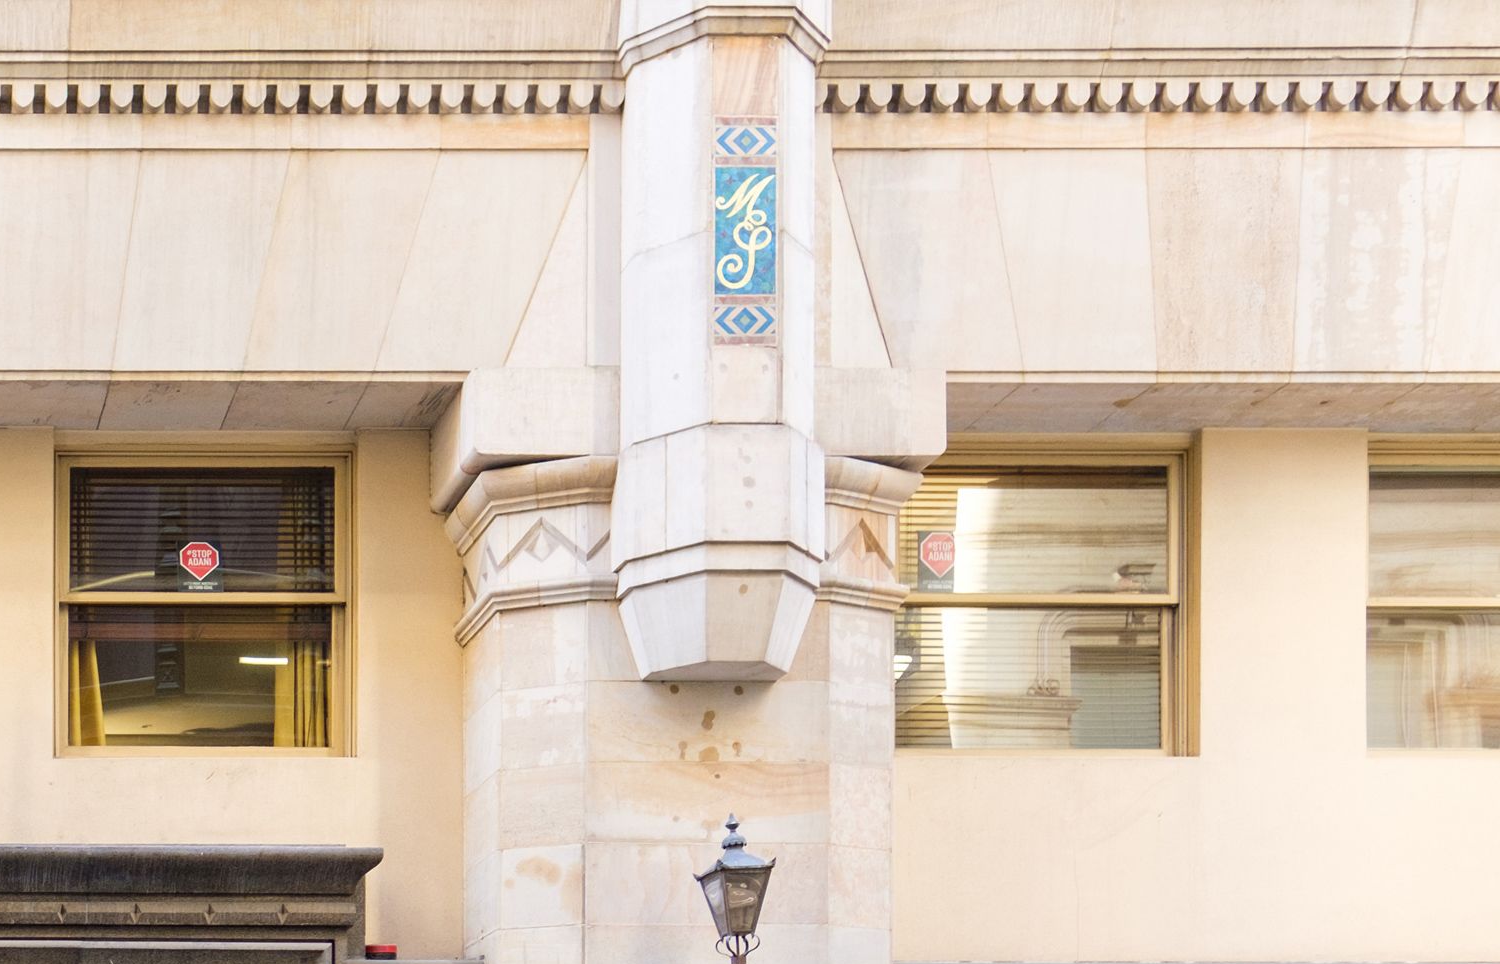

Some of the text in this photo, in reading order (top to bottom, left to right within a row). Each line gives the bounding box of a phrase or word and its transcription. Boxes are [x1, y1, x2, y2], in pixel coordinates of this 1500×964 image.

[187, 549, 212, 558] #STOP
[928, 551, 953, 561] ADANI
[188, 558, 212, 566] ADANI
